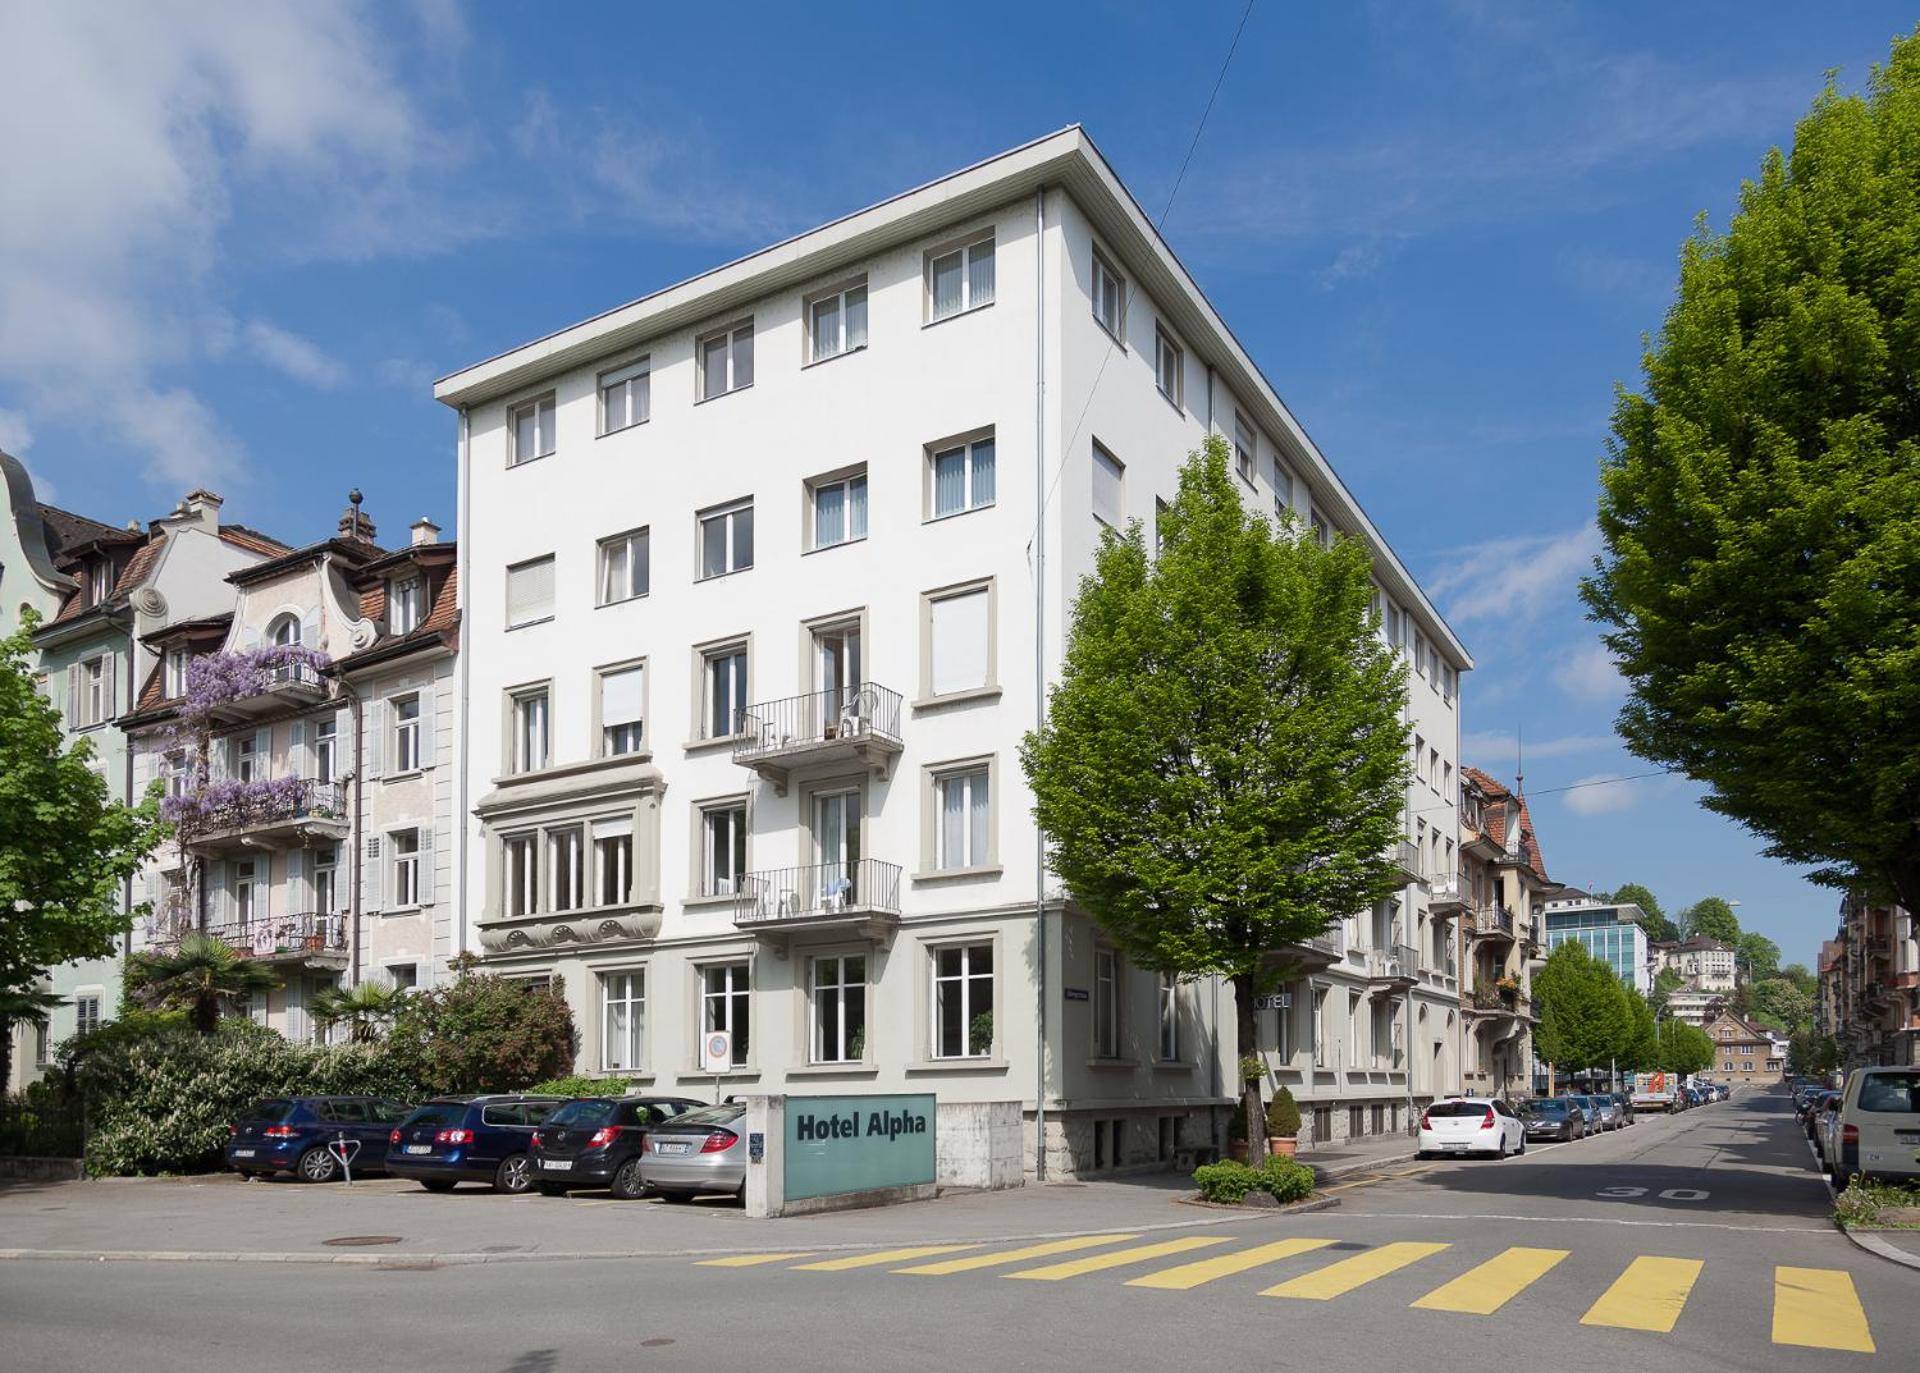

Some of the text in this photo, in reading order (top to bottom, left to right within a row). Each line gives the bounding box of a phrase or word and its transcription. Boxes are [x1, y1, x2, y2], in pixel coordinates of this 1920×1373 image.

[797, 1109, 926, 1142] Hotel Alpha
[1595, 1186, 1711, 1200] 30
